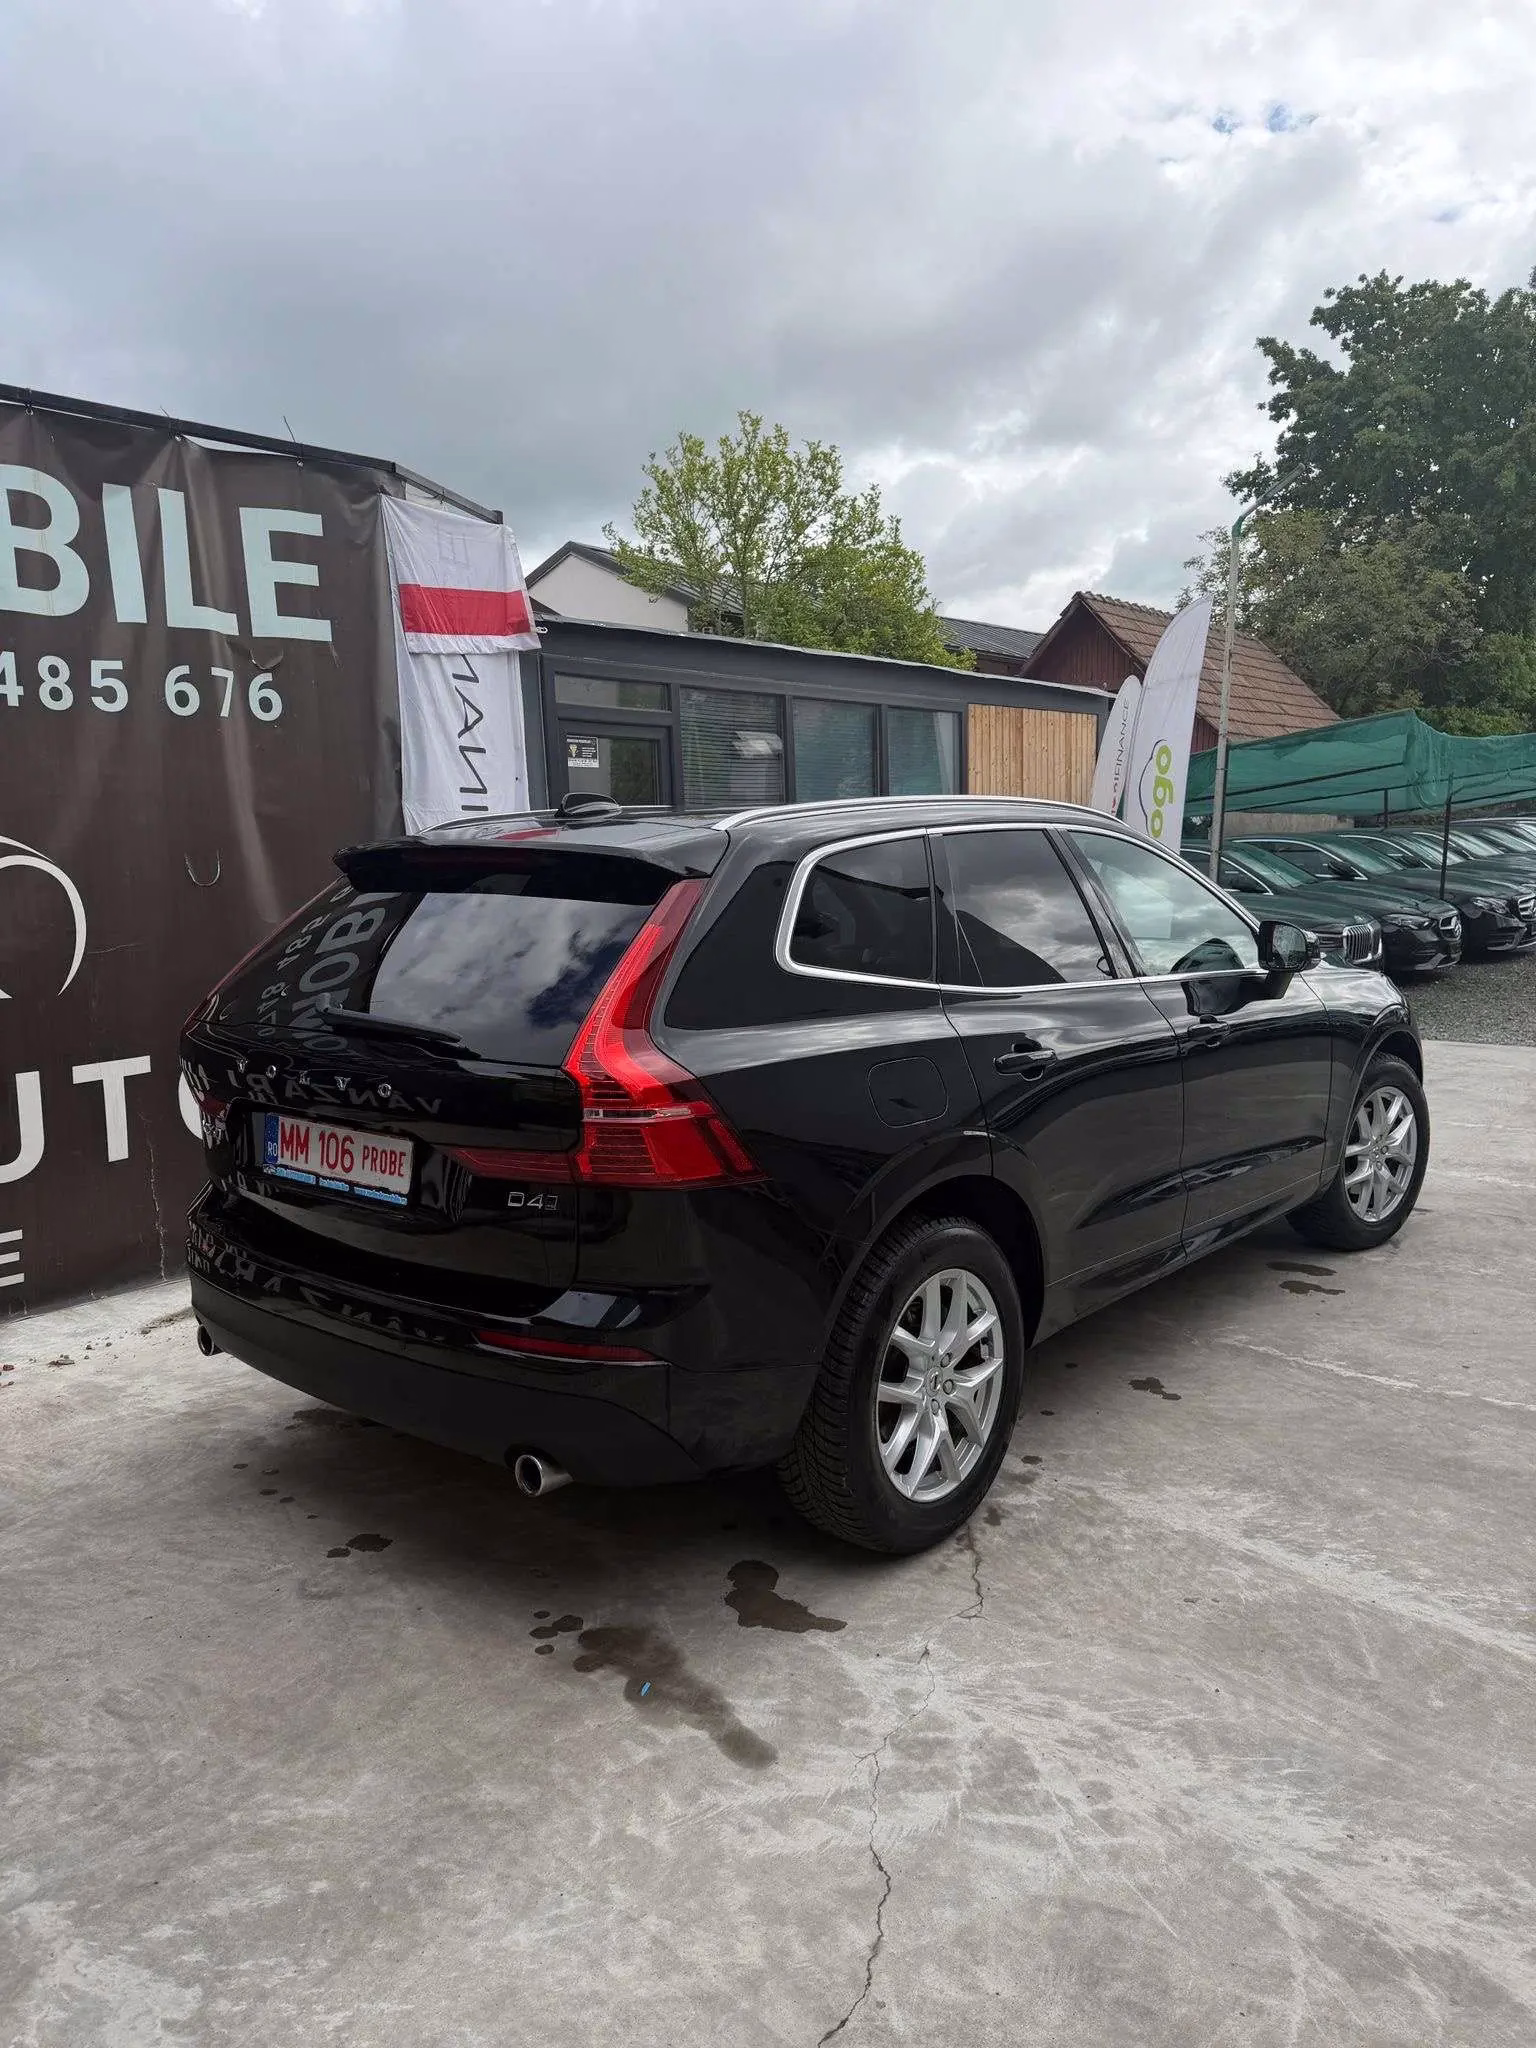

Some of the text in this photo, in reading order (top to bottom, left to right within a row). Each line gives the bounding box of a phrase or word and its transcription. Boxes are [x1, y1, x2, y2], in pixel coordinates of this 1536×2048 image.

[0, 464, 333, 642] BILE
[0, 651, 283, 722] 485 676
[267, 1141, 278, 1157] RO
[280, 1120, 310, 1165] MM
[318, 1130, 355, 1174] 106
[361, 1145, 407, 1178] PROBE
